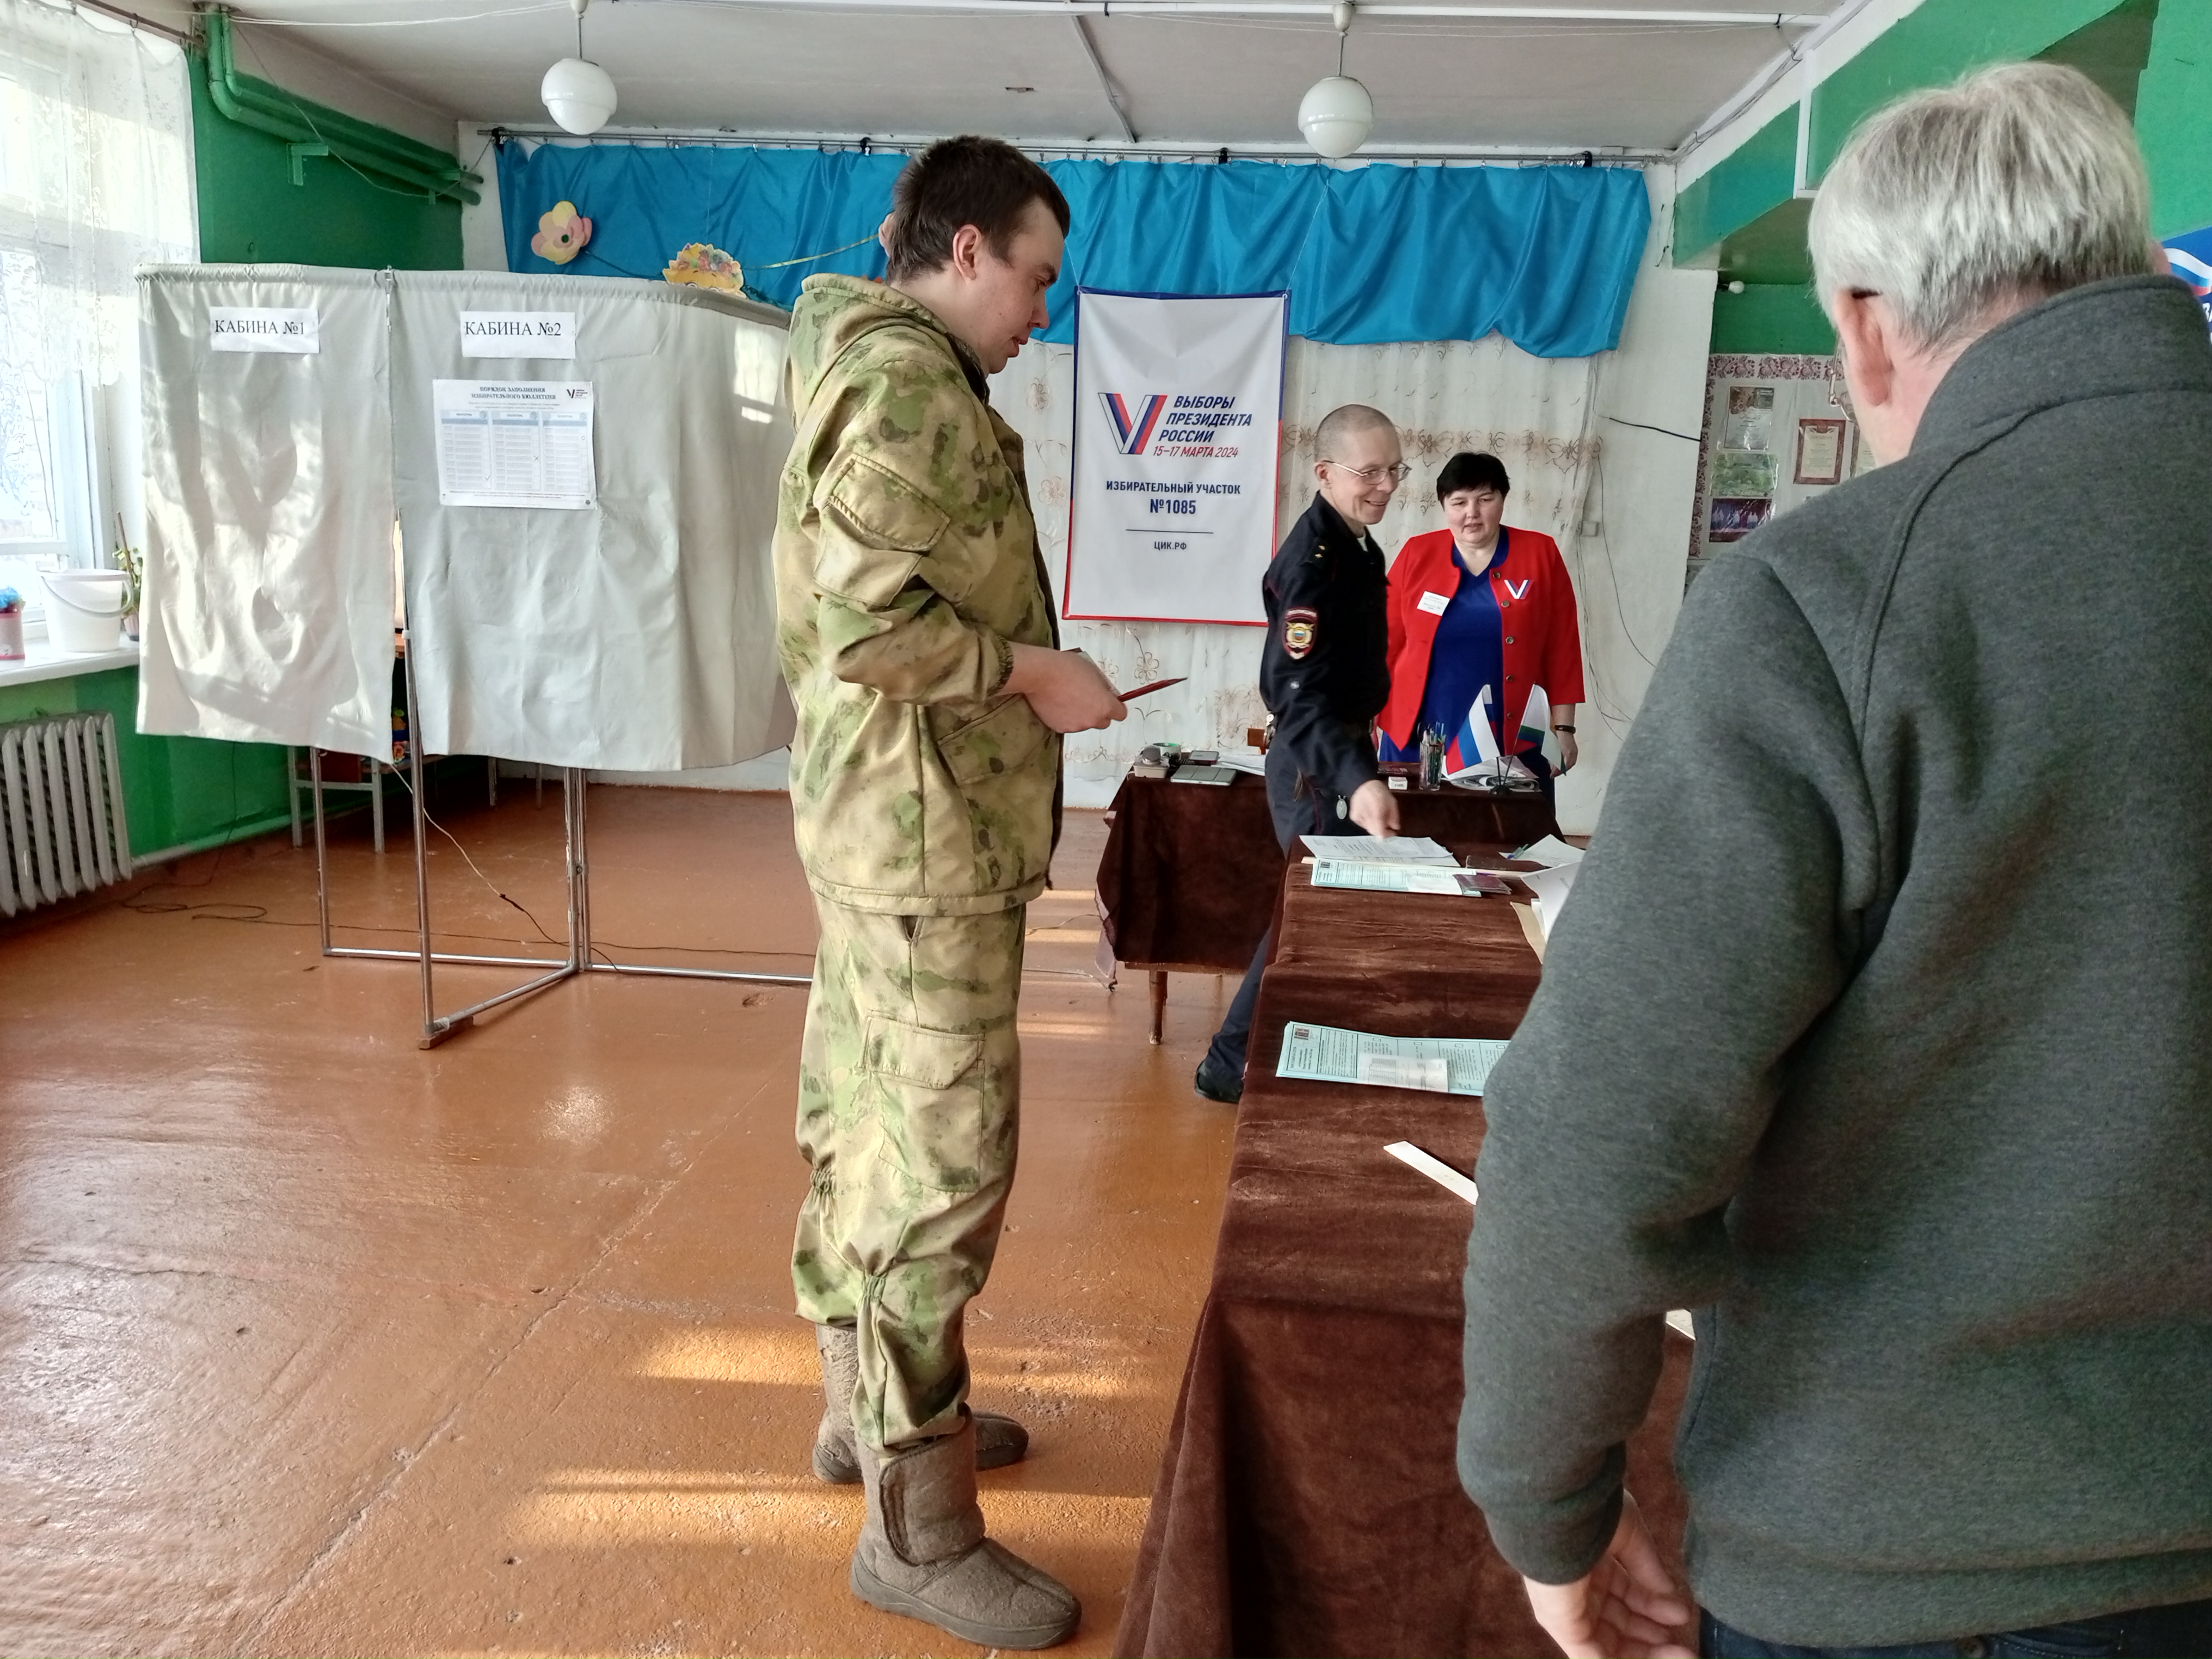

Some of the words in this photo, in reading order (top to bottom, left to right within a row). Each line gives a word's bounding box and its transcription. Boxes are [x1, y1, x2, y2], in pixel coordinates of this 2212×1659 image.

[215, 319, 279, 334] КАБИНА
[282, 321, 304, 335] №1
[465, 322, 533, 336] КАБИНА
[537, 322, 561, 336] №2
[1173, 396, 1236, 409] ВЫБОРЫ
[1166, 413, 1252, 428] ПРЕЗИДЕНТА
[1158, 429, 1215, 443] РОССИИ
[1181, 446, 1214, 457] МАРТА
[1215, 447, 1239, 458] 2024
[1106, 481, 1194, 493] ИЗБИРАТЕЛЬНЫЙ
[1196, 483, 1241, 494] УЧАСТОК
[1150, 499, 1196, 514] №1085
[1154, 541, 1187, 551] ЦИК.РФ
